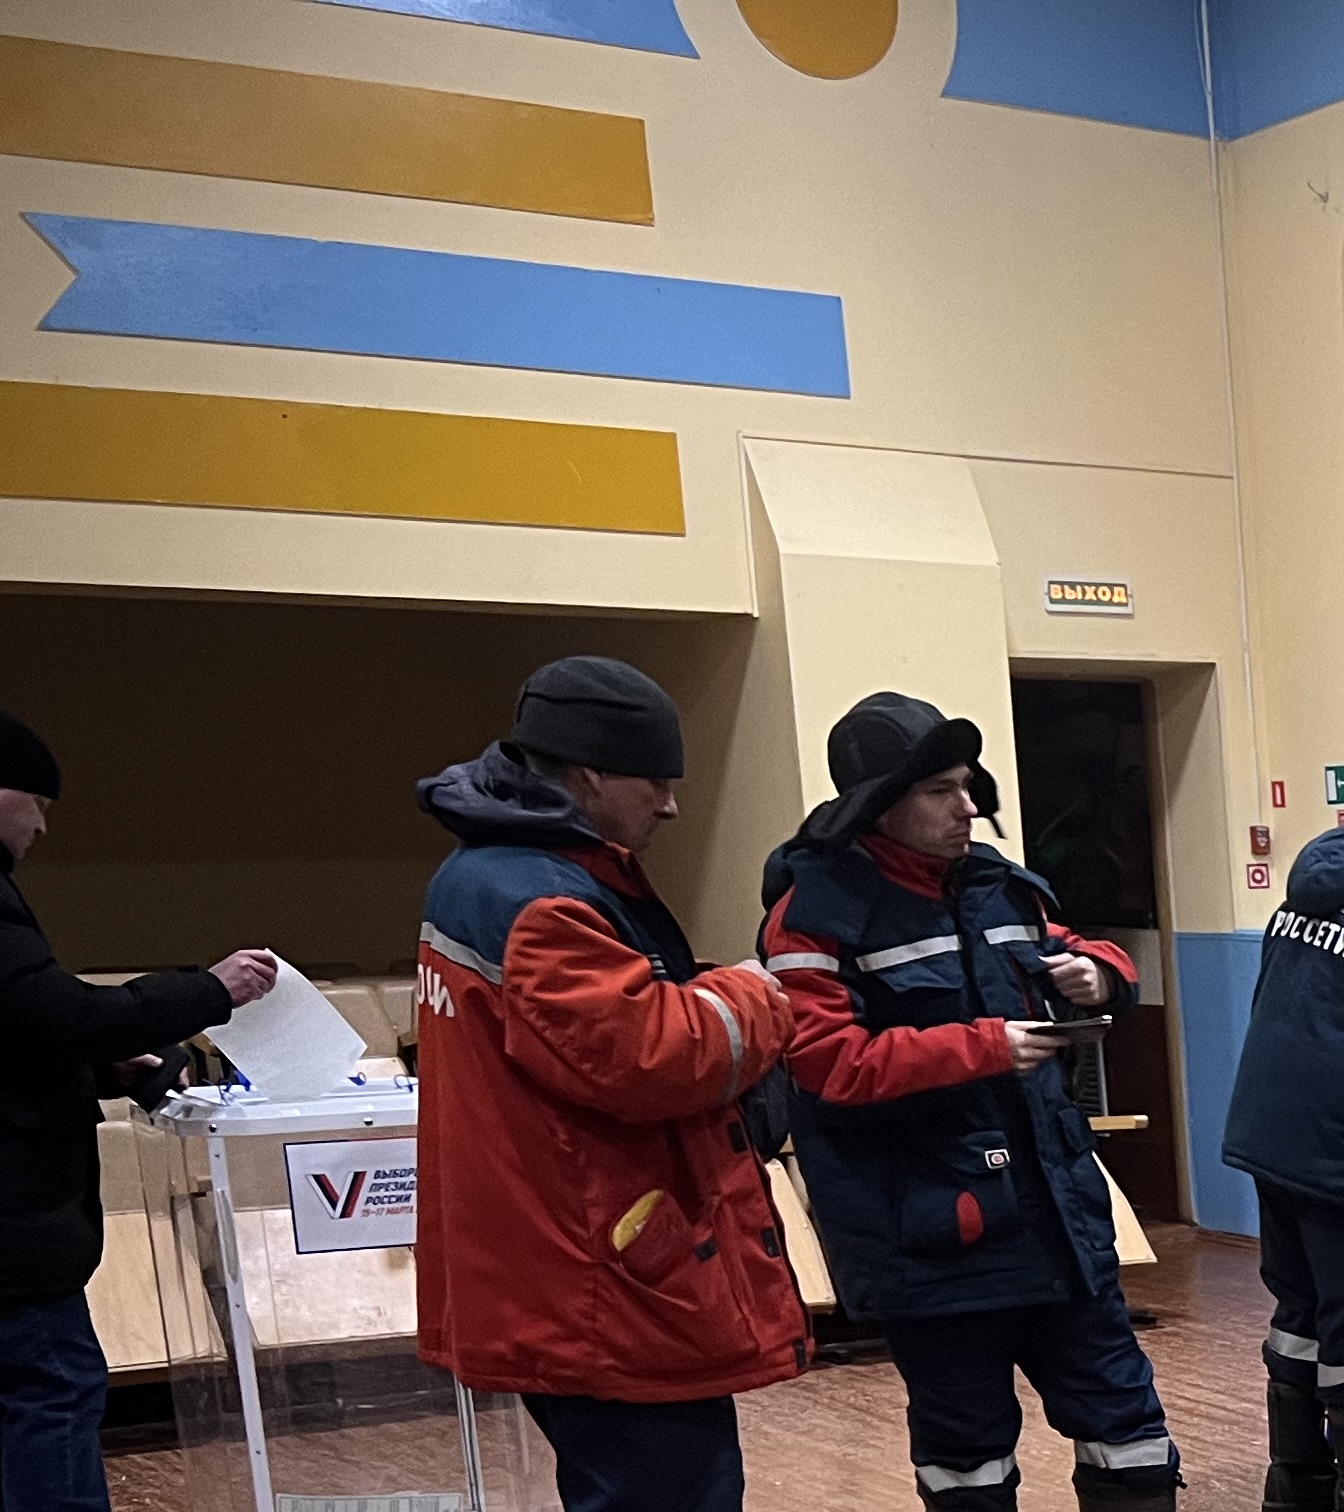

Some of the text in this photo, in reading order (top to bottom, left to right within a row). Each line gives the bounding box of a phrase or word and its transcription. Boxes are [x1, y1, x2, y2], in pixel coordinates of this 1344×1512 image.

[1050, 584, 1127, 603] ВЫХОД
[374, 1168, 417, 1179] ВЫБОР
[368, 1181, 416, 1193] ПРЕЗИД
[365, 1193, 412, 1206] РОССИИ
